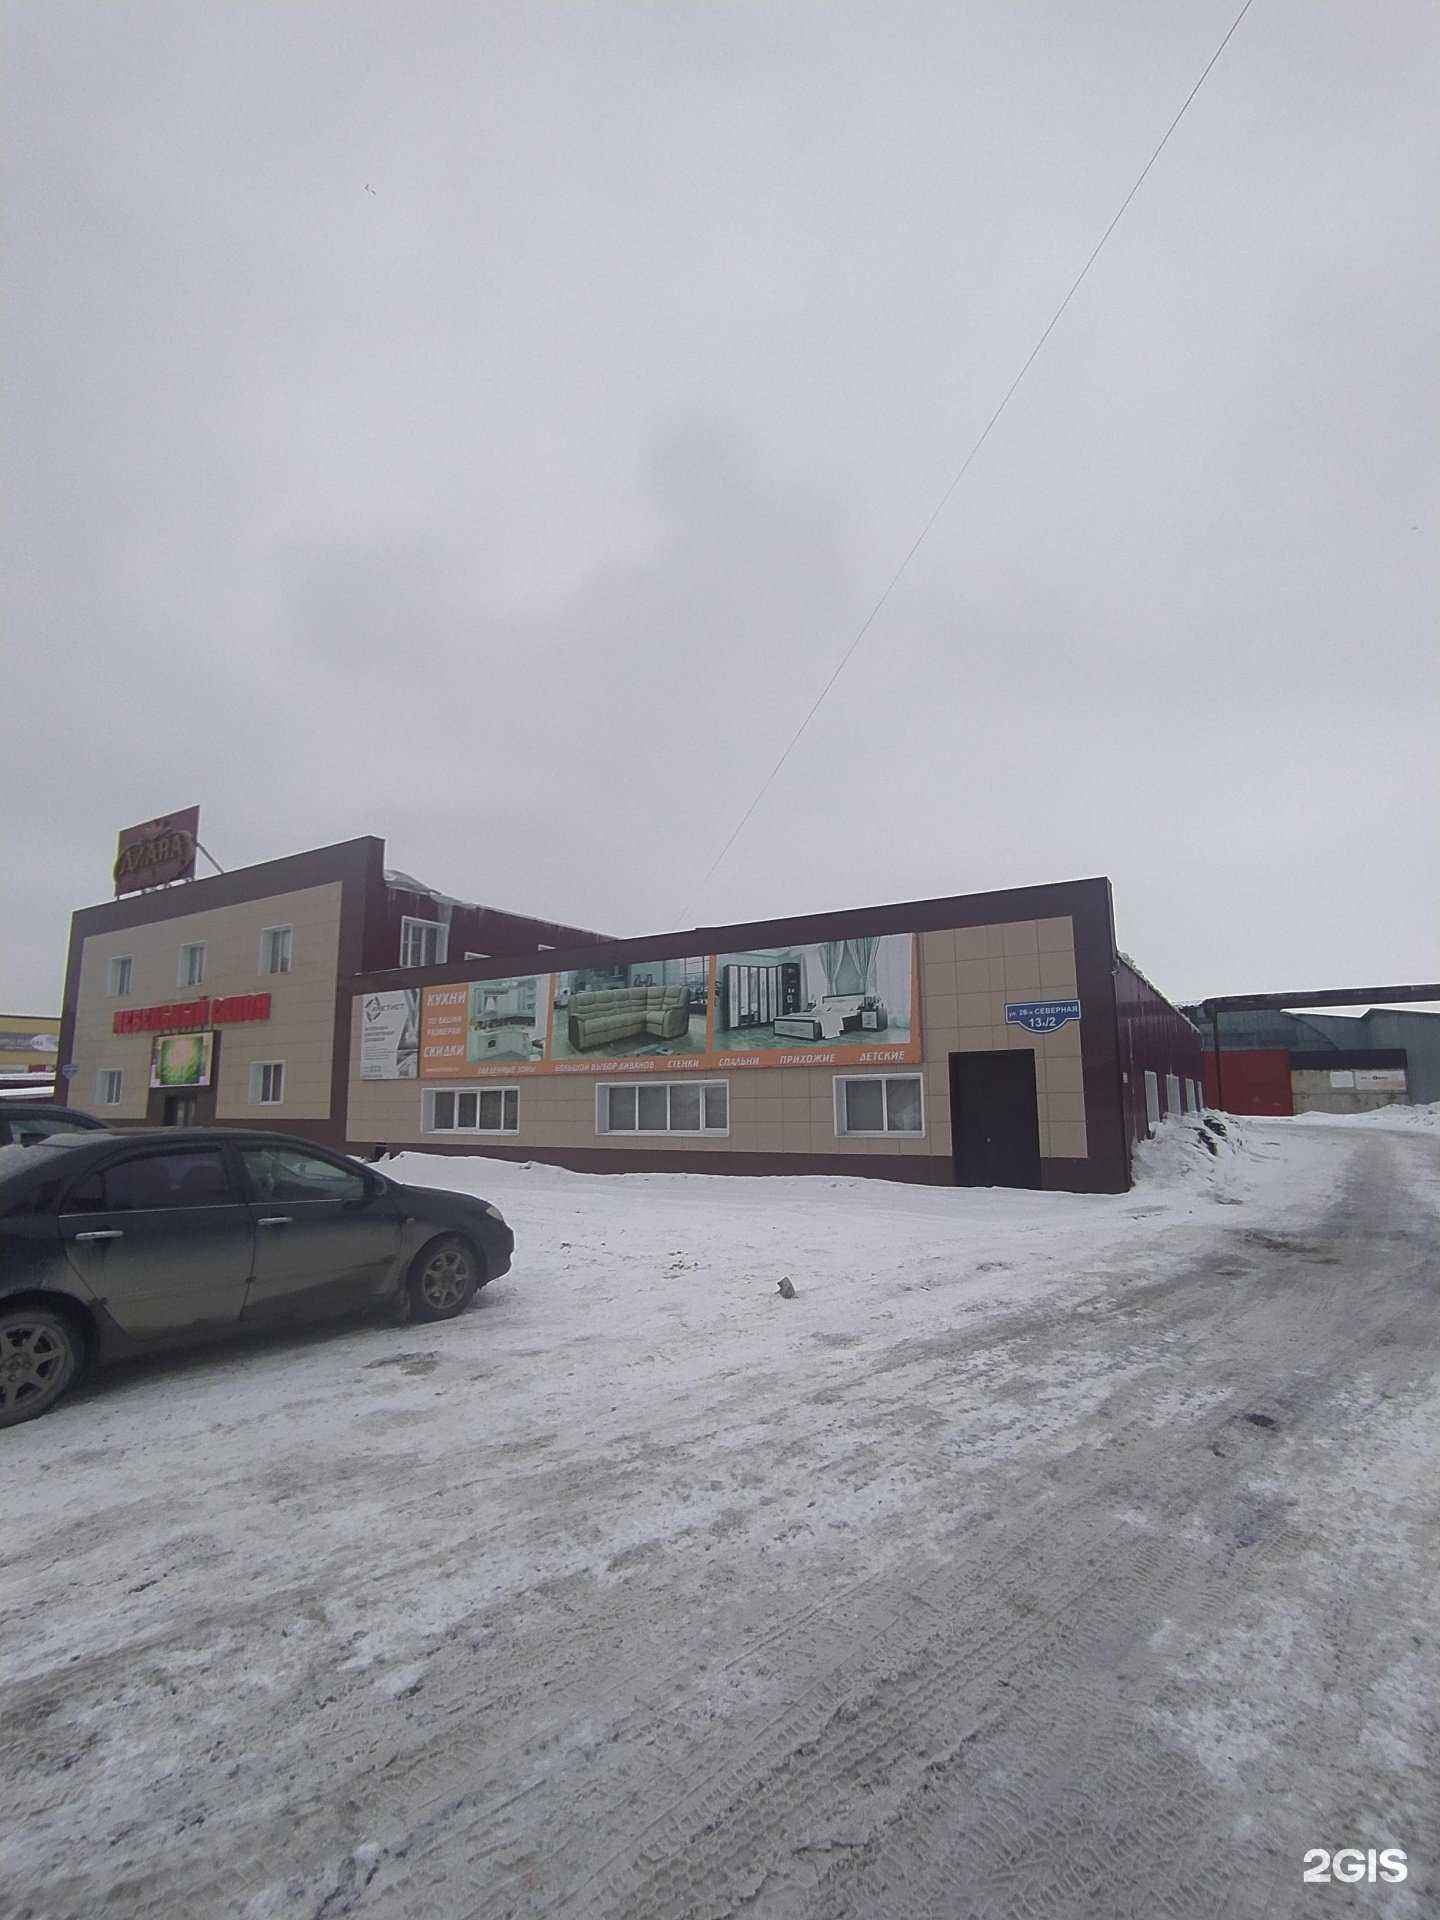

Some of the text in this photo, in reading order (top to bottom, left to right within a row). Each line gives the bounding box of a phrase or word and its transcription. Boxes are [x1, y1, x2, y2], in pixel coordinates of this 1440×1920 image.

[427, 991, 466, 1006] КУХНИ
[1034, 1006, 1078, 1014] СЕВЕРНАЯ
[424, 1045, 465, 1057] СКИДКИ
[668, 1059, 700, 1068] СТЕНКИ
[719, 1056, 760, 1067] СПАЛЬНИ
[780, 1053, 836, 1065] ПРИХОЖИЕ
[859, 1050, 905, 1063] ДЕТСКИЕ
